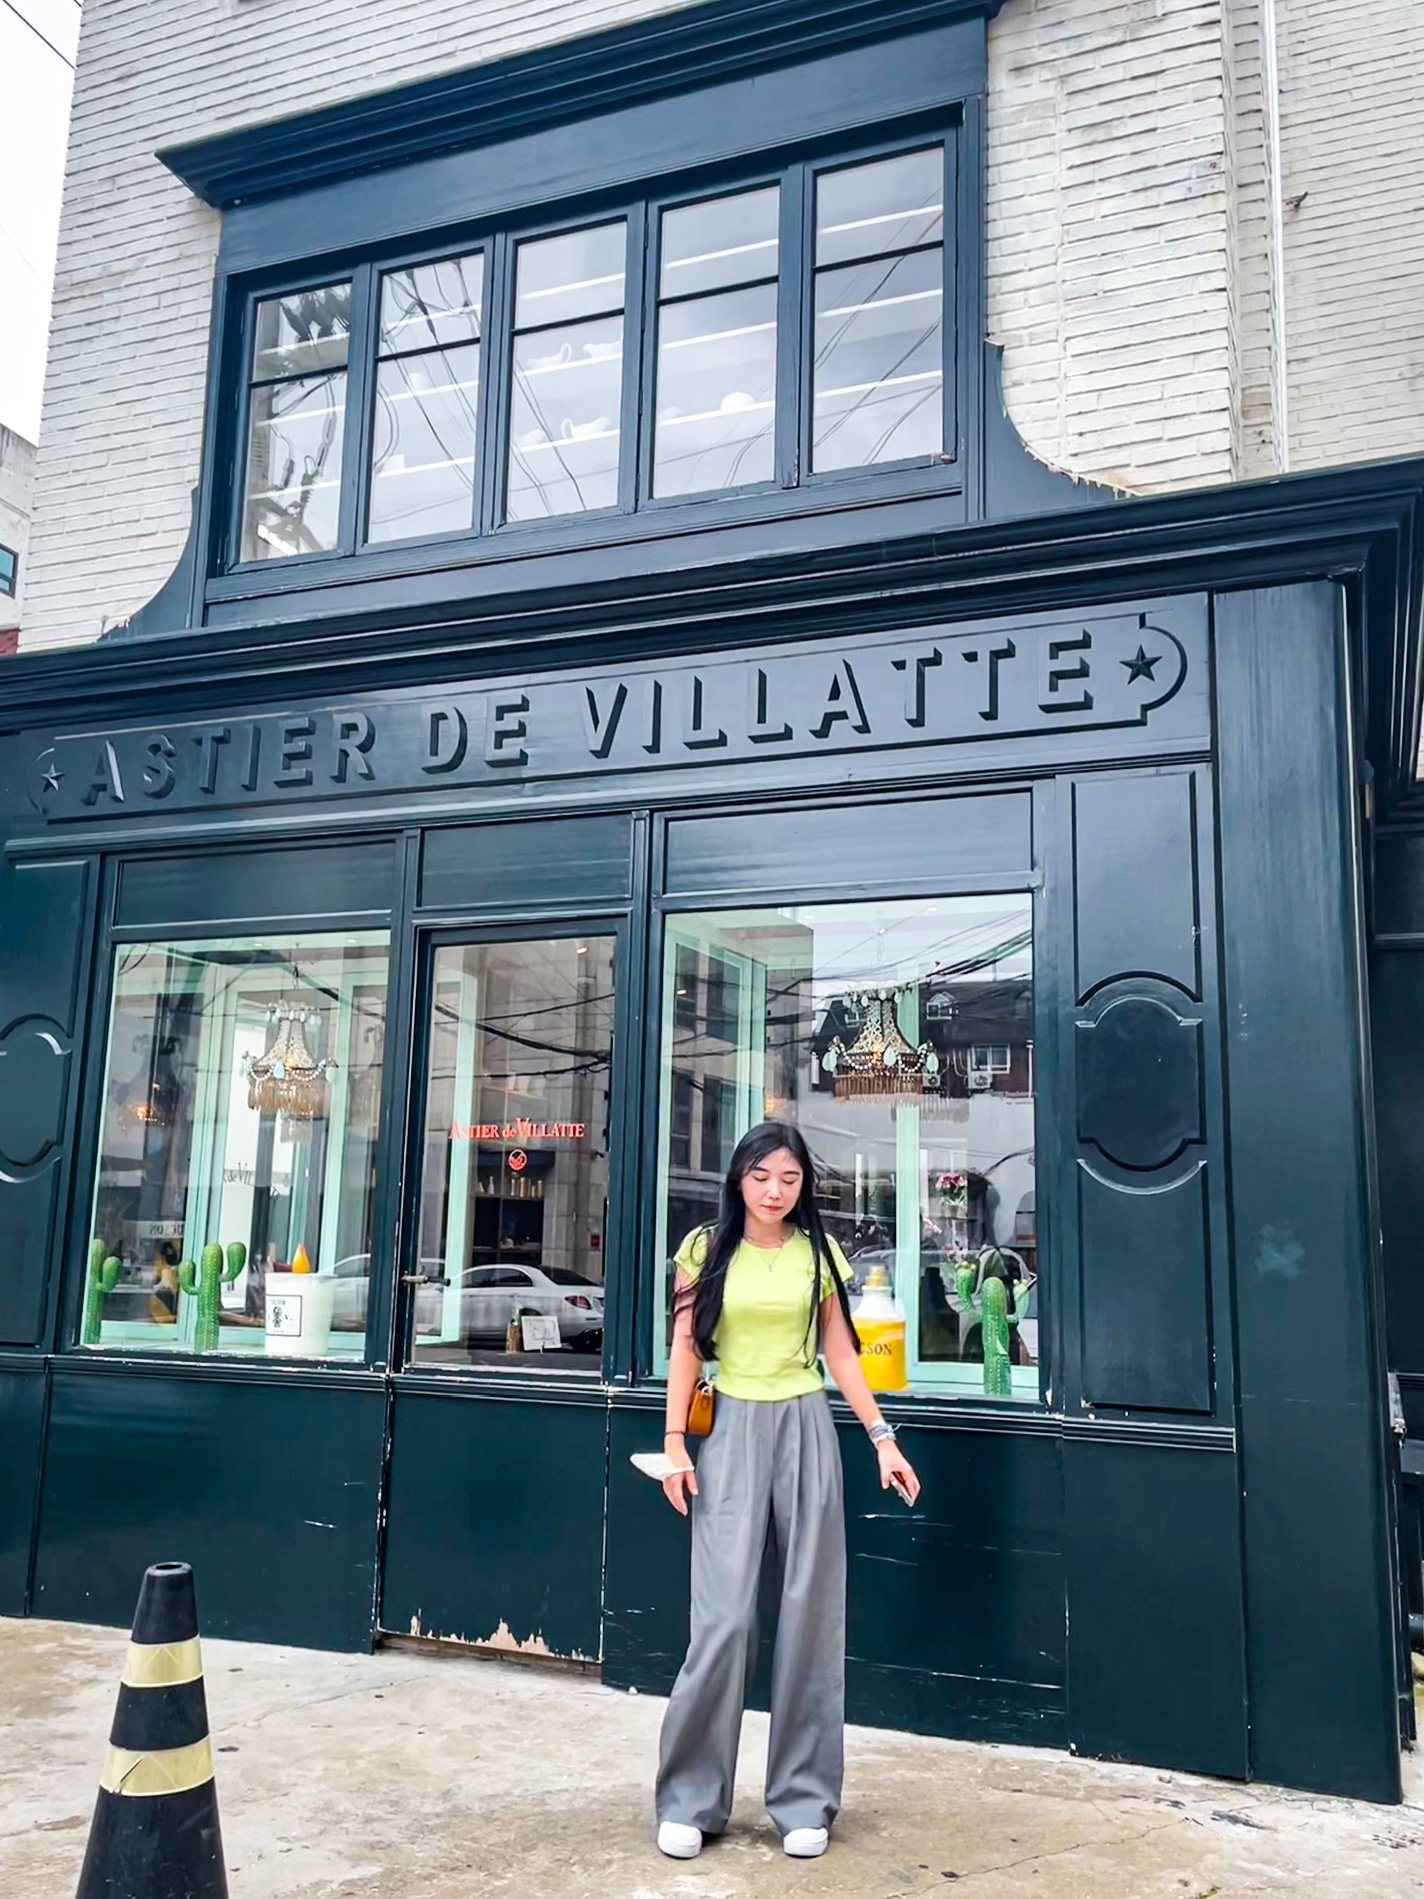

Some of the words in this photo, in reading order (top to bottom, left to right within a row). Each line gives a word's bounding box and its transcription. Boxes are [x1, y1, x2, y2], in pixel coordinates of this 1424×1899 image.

[84, 710, 376, 806] ASTIER
[421, 694, 530, 775] DE
[580, 628, 1094, 759] VILLATTE
